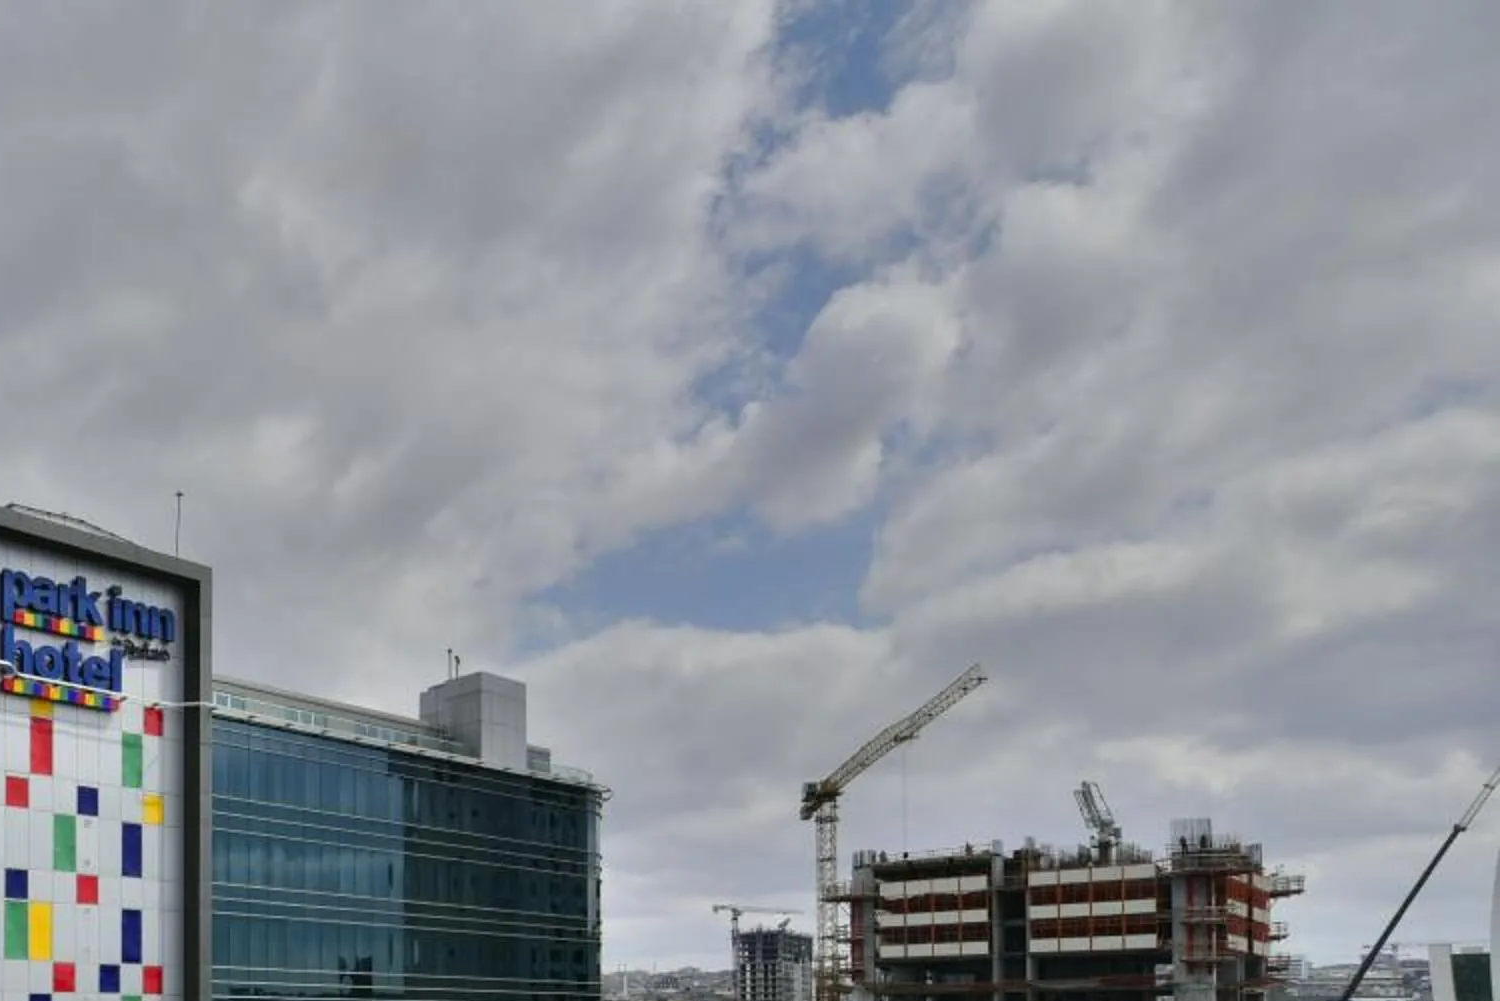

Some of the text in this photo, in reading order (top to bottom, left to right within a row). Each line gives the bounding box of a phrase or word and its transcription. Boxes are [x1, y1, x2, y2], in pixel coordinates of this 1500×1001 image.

[0, 568, 175, 642] park inn
[1, 622, 123, 694] hotel
